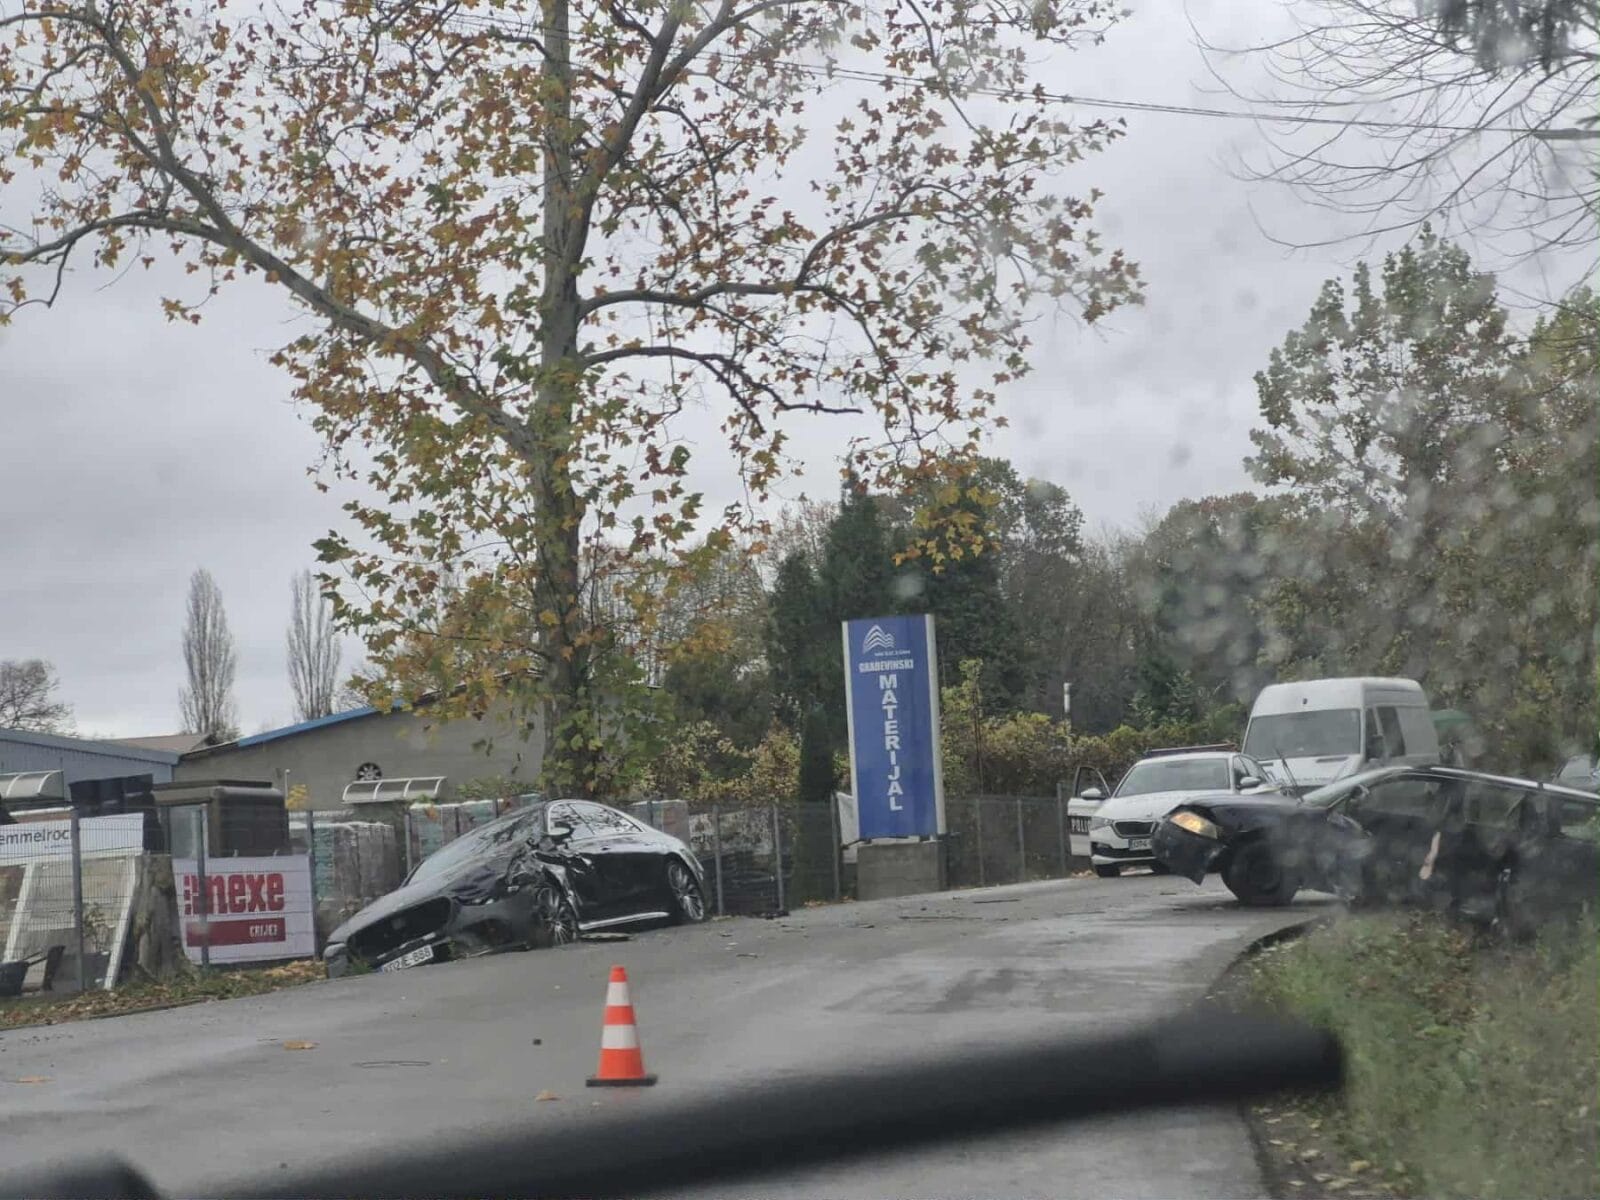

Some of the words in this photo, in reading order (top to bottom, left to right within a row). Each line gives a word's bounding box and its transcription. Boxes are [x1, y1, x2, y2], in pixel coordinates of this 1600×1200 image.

[879, 674, 903, 811] MATERIJAL
[0, 829, 71, 845] emmelroc
[192, 873, 284, 914] nexe
